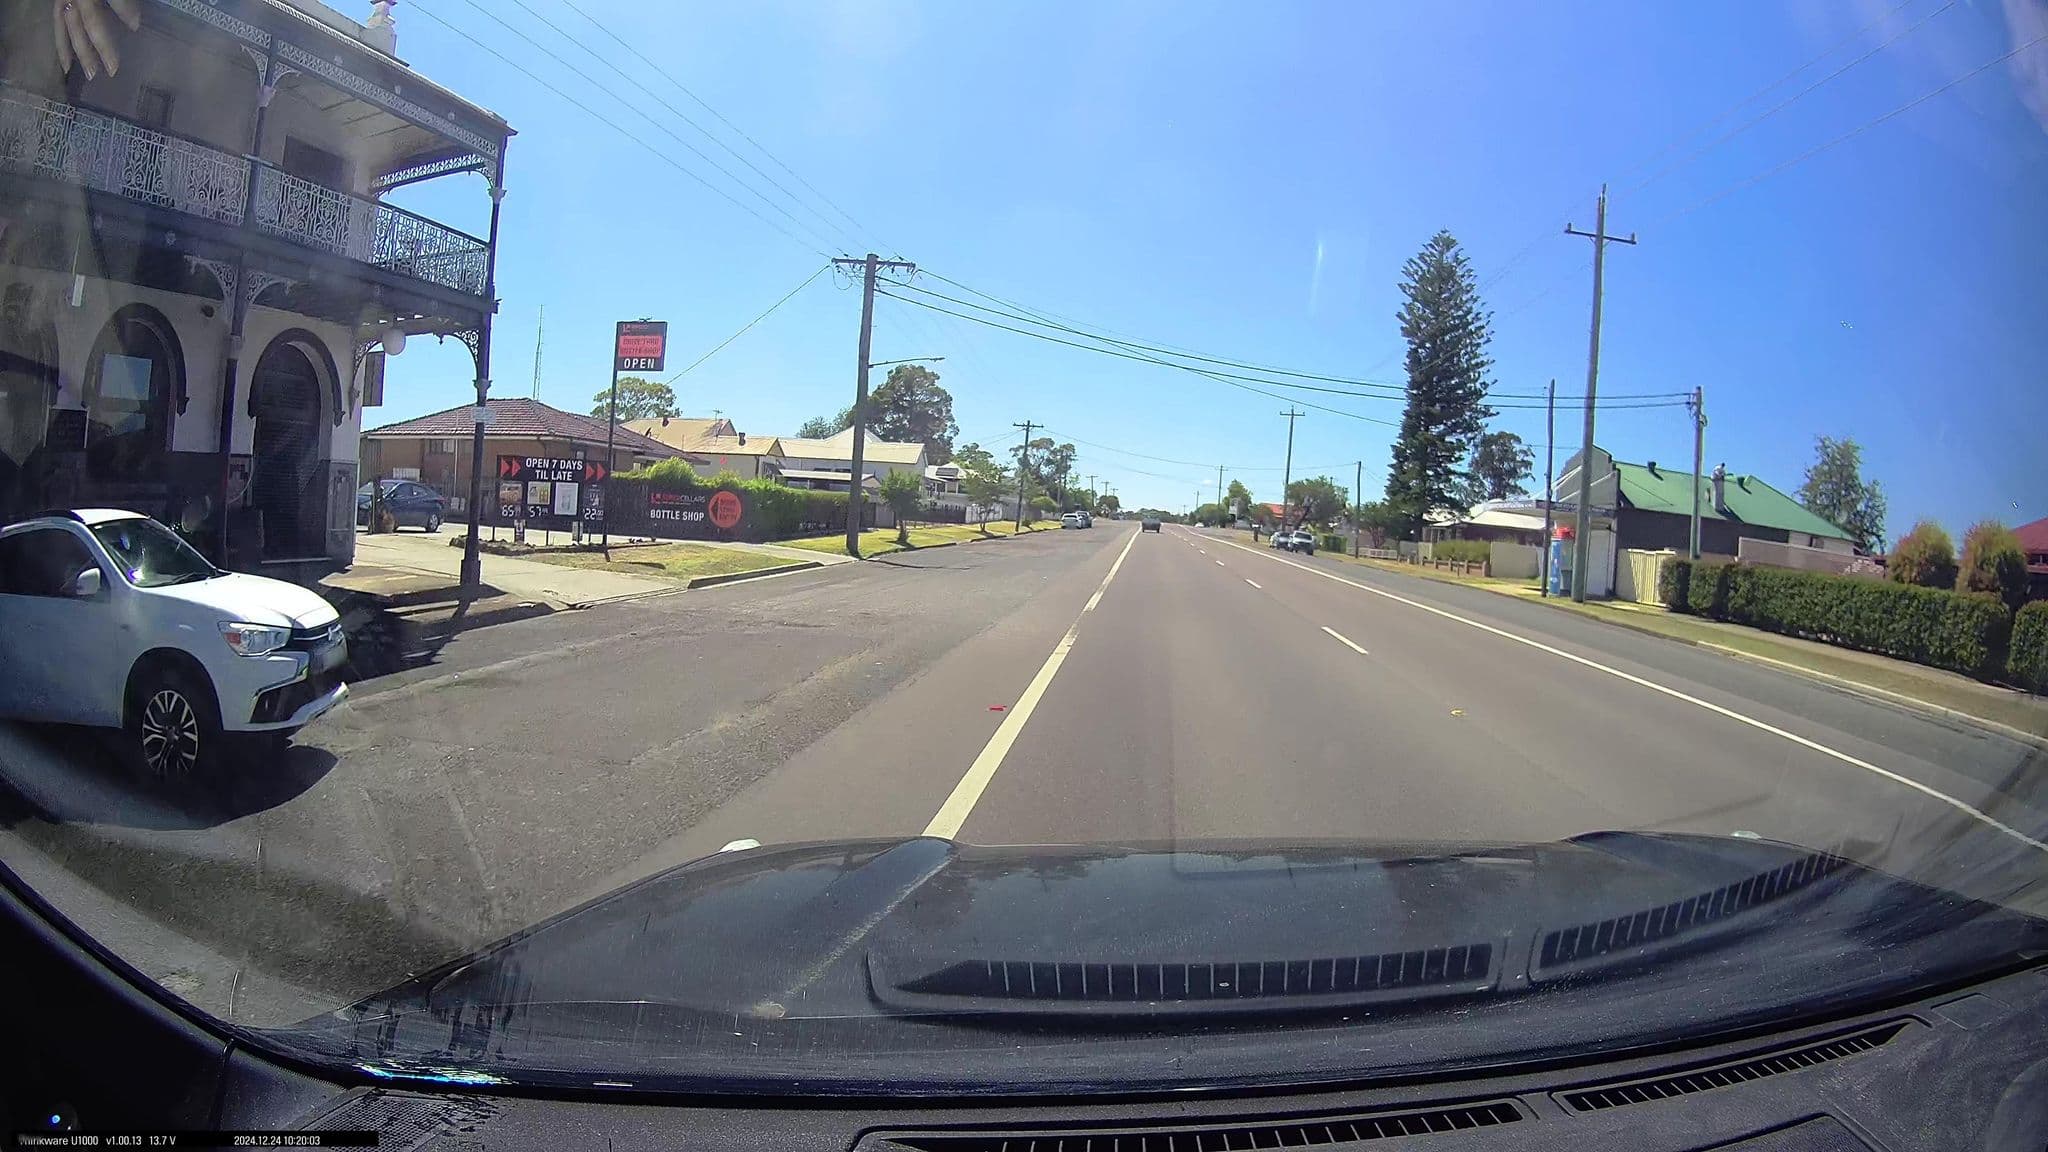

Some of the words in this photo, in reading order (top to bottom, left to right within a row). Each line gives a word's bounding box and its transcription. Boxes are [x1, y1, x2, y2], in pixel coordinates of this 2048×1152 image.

[624, 358, 655, 368] OPEN
[526, 458, 549, 469] OPEN
[552, 459, 557, 469] 7
[560, 459, 583, 471] DAYS
[535, 470, 549, 480] TIL
[551, 470, 573, 481] LATE
[650, 509, 681, 520] BOTTLE
[682, 511, 705, 522] SHOP
